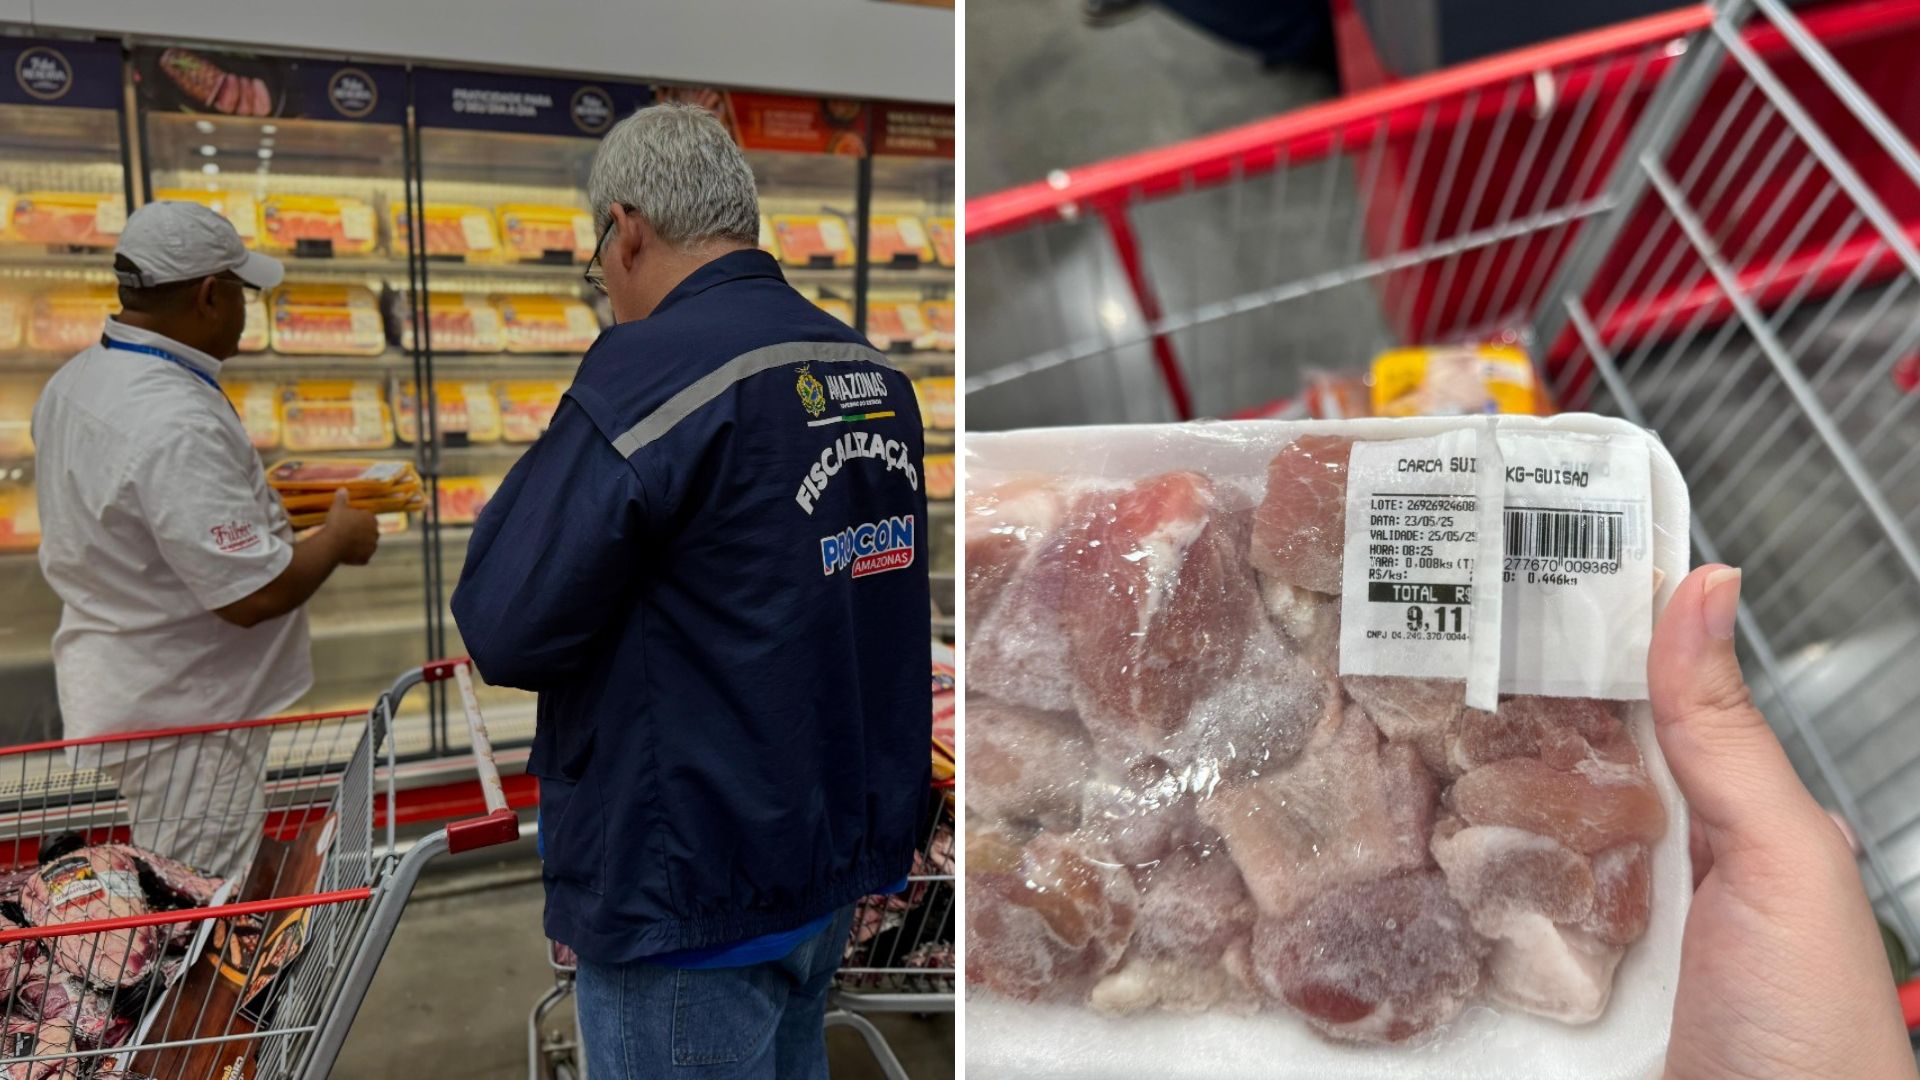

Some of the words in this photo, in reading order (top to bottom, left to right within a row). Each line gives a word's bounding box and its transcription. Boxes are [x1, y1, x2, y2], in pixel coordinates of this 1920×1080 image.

[825, 372, 888, 401] AMAZONAS
[1398, 458, 1443, 473] CARCA
[1371, 499, 1403, 511] LOTE:
[1370, 515, 1400, 526] DATA:
[1405, 516, 1454, 527] 23/05/25
[1370, 530, 1424, 541] VALIDADE:
[821, 515, 914, 575] PROCON
[1370, 544, 1399, 555] HORA:
[1402, 545, 1433, 556] 08:25
[855, 552, 909, 573] AMAZONAS
[1370, 556, 1399, 567] TARA:
[1564, 560, 1618, 575] 009369
[1369, 568, 1408, 580] R$/kg:
[1393, 585, 1438, 602] TOTAL
[1406, 605, 1463, 633] 9,11
[1367, 630, 1388, 639] CNPJ
